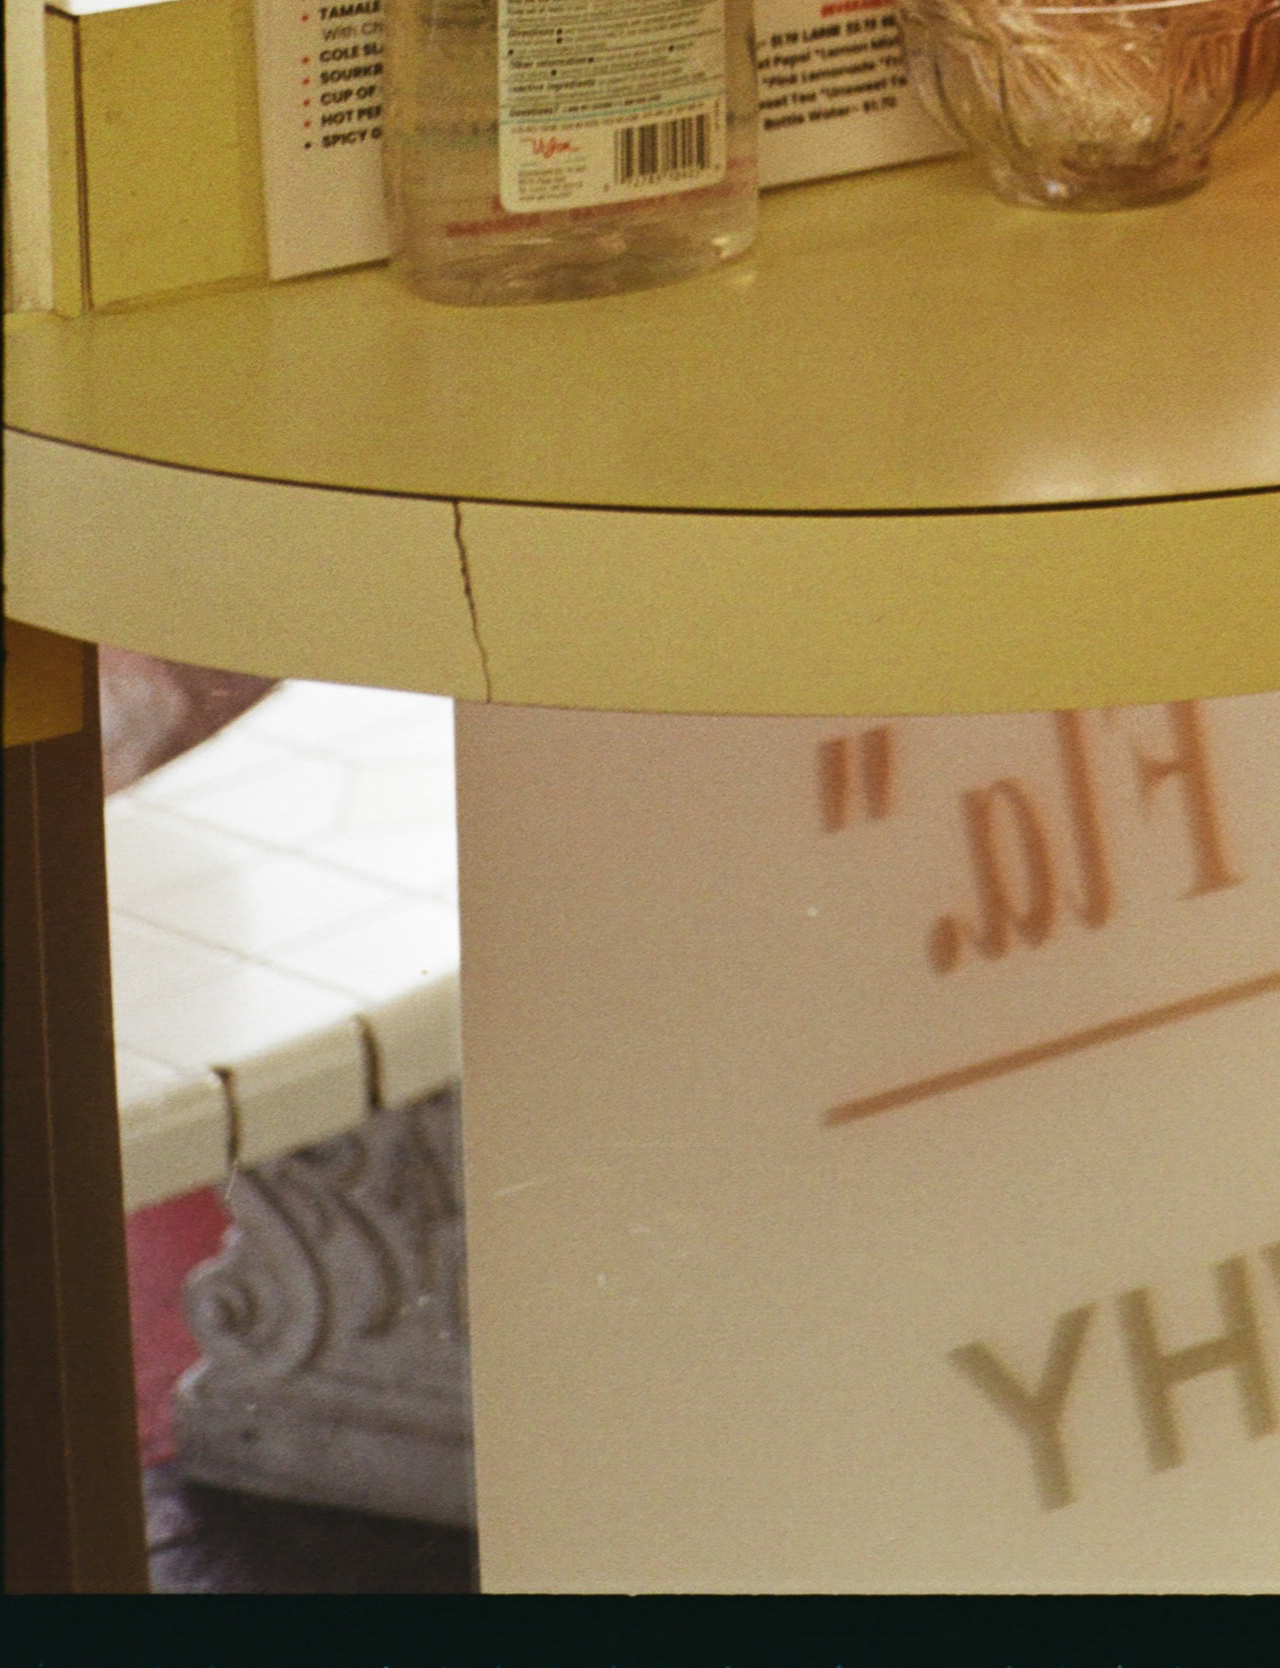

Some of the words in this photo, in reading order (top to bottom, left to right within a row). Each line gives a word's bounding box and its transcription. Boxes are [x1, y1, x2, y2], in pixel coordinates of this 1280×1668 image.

[318, 0, 382, 21] TAMALE
[320, 45, 358, 64] COLE
[320, 89, 353, 106] CUP
[356, 84, 377, 99] OF
[320, 108, 353, 128] HOT
[322, 128, 368, 149] SPICY
